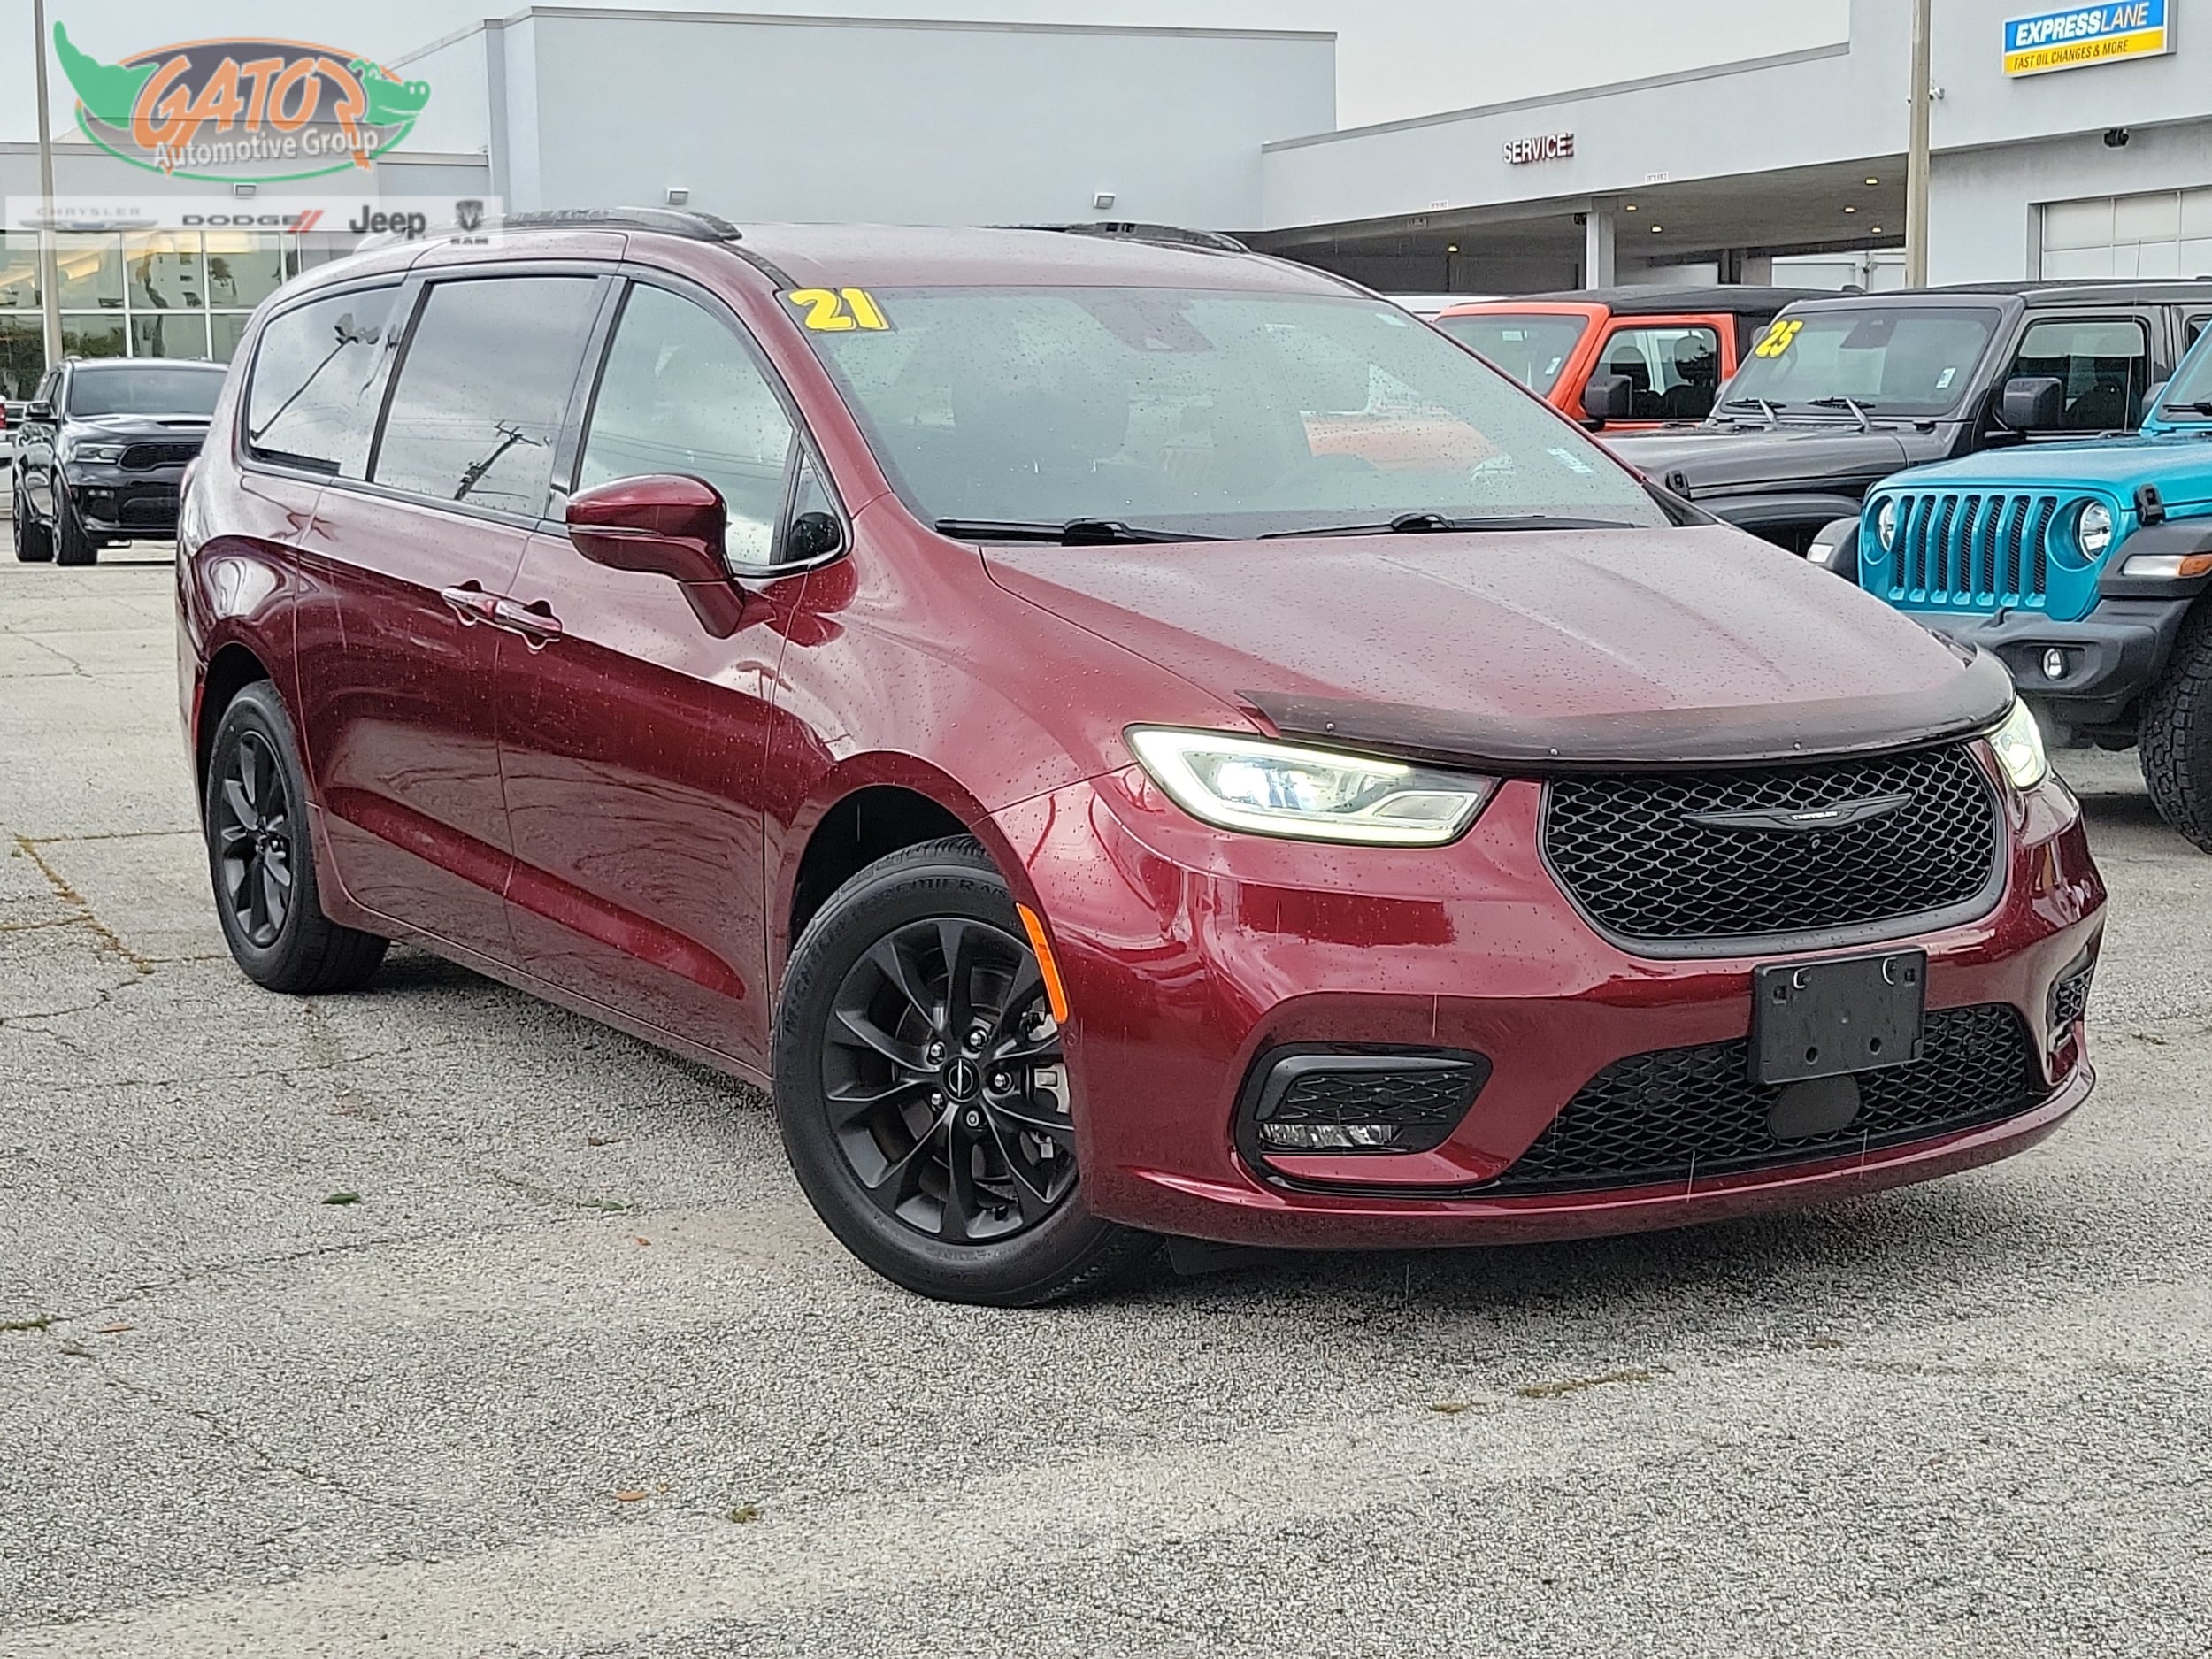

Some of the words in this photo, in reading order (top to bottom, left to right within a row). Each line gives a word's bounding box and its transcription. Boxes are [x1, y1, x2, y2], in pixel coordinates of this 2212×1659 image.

[2014, 55, 2035, 70] FAST
[2036, 52, 2050, 66] OIL
[2051, 46, 2091, 65] CHANGES
[2093, 44, 2100, 57] &
[2102, 39, 2129, 55] MORE
[1502, 134, 1571, 164] SERVICE
[788, 288, 890, 332] 21
[1755, 319, 1804, 358] 25
